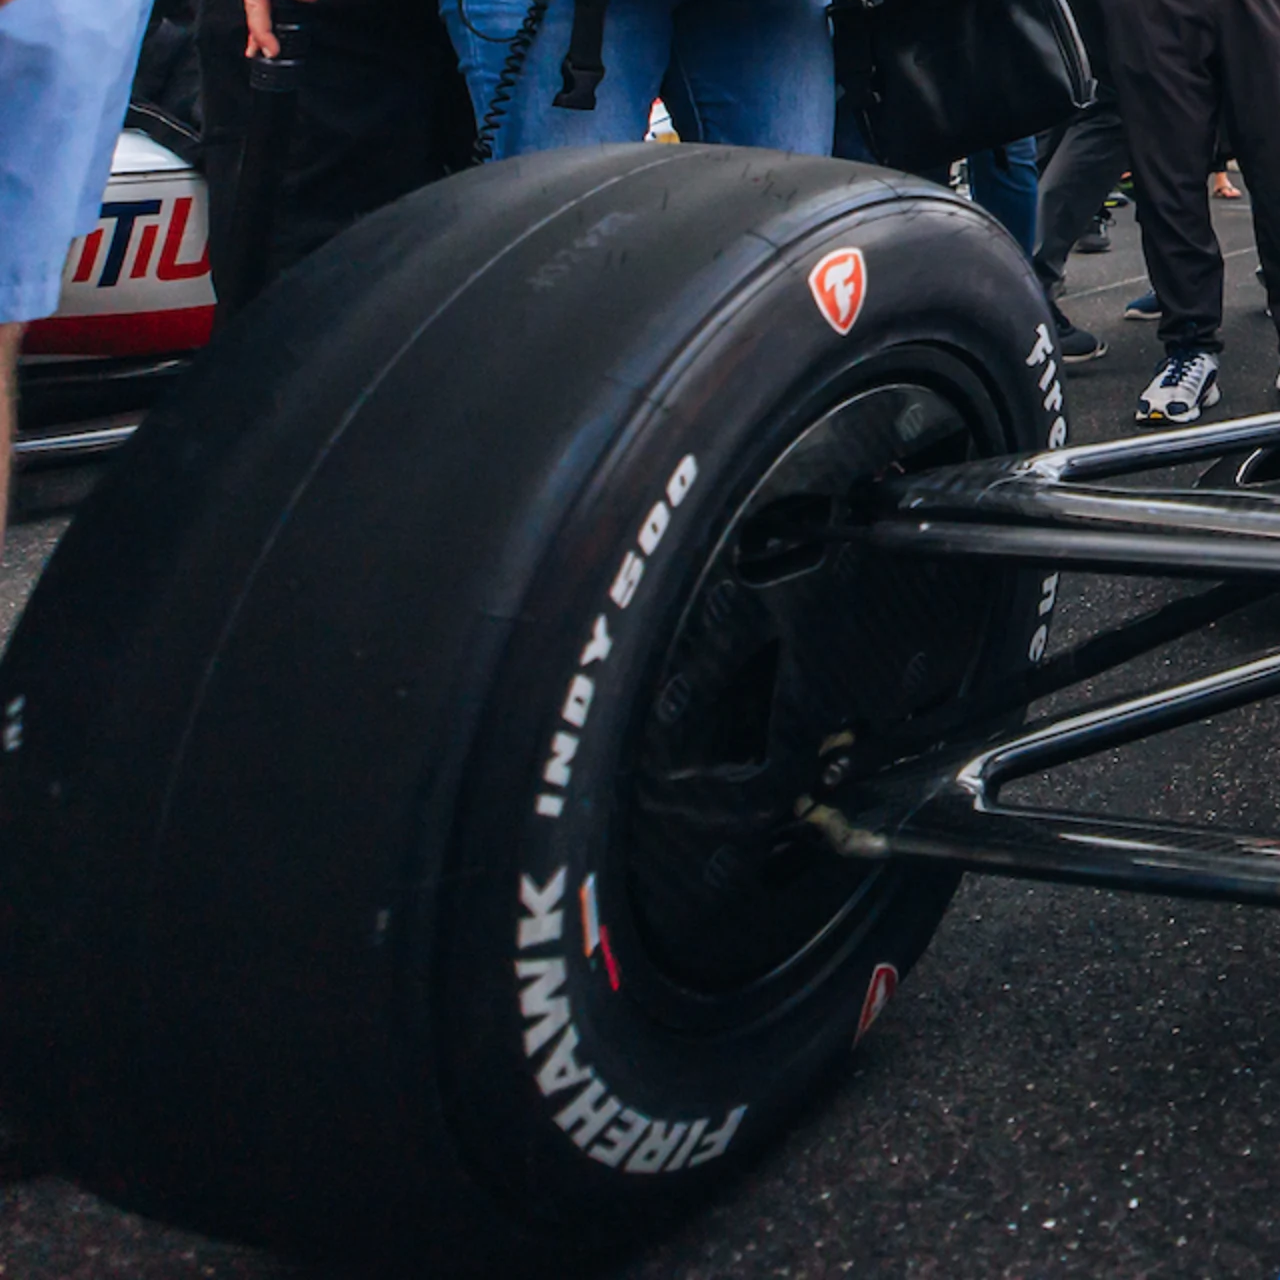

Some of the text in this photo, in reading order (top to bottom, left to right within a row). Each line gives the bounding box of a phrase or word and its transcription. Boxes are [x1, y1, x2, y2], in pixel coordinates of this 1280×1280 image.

[535, 452, 699, 817] INDY 500
[514, 865, 750, 1173] FIREHAWK
